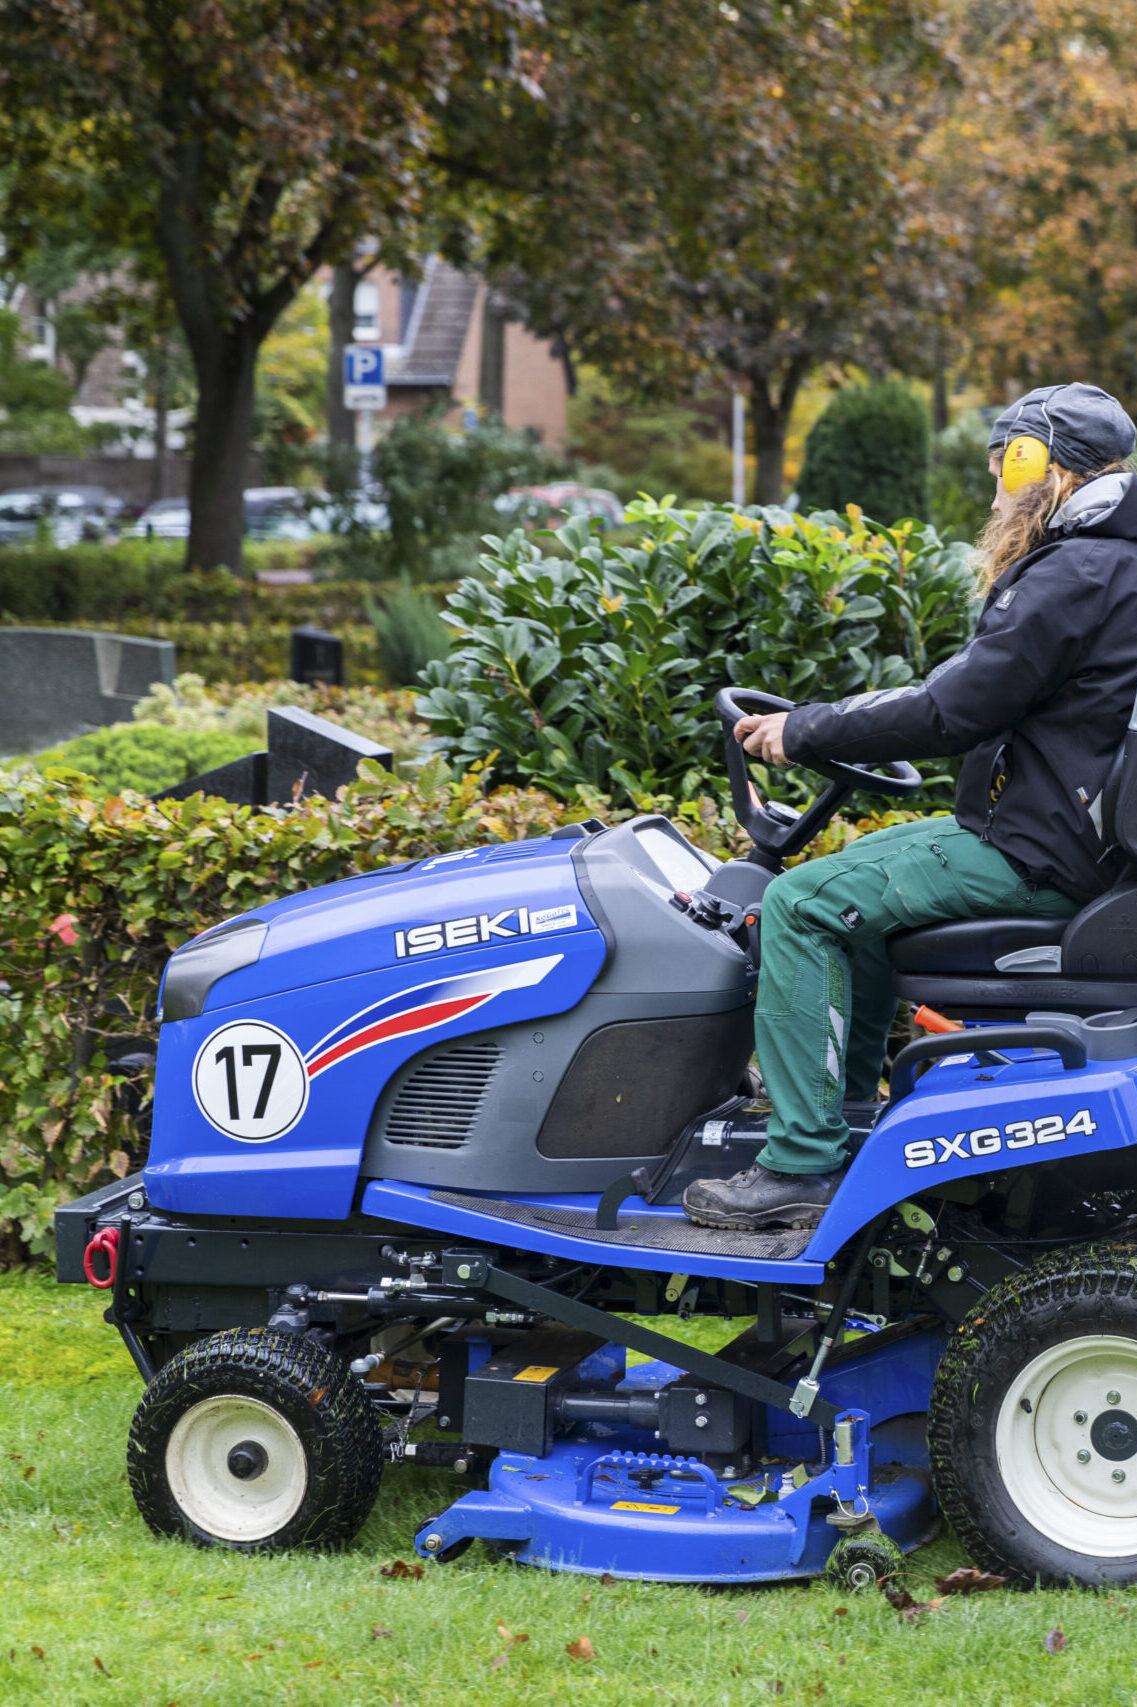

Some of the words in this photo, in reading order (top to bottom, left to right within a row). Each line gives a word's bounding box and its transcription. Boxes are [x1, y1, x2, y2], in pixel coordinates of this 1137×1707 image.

[354, 349, 377, 382] P
[394, 906, 530, 959] ISEKI
[215, 1044, 281, 1120] 17
[904, 1108, 1097, 1169] SXG324
